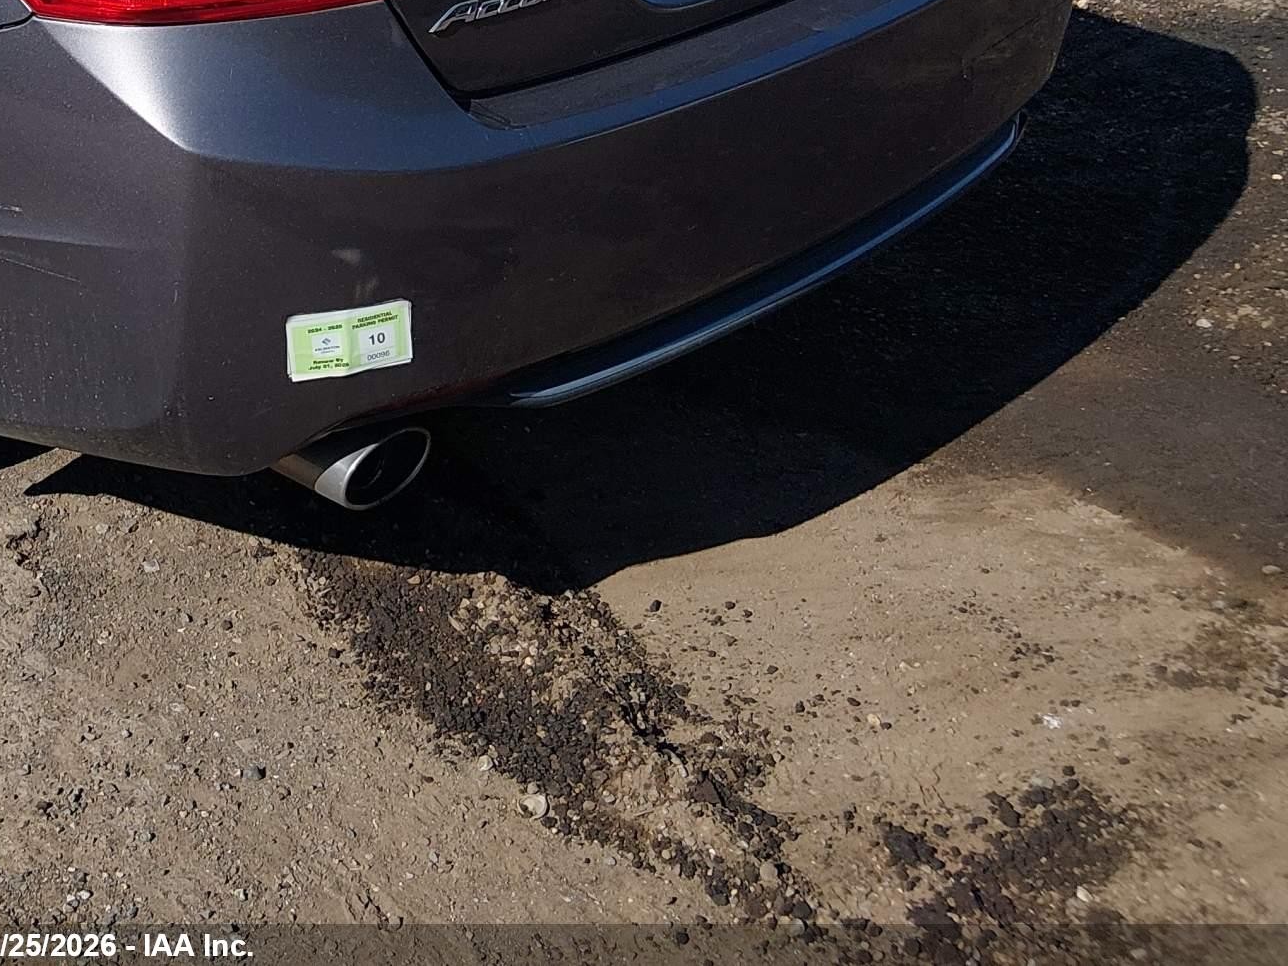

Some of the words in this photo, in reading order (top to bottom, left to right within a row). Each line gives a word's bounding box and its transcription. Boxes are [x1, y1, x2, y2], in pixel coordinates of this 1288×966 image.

[352, 320, 376, 330] PARKING
[377, 315, 398, 323] PERMIT
[357, 311, 392, 323] RESIDENTIAL
[369, 332, 385, 346] 10
